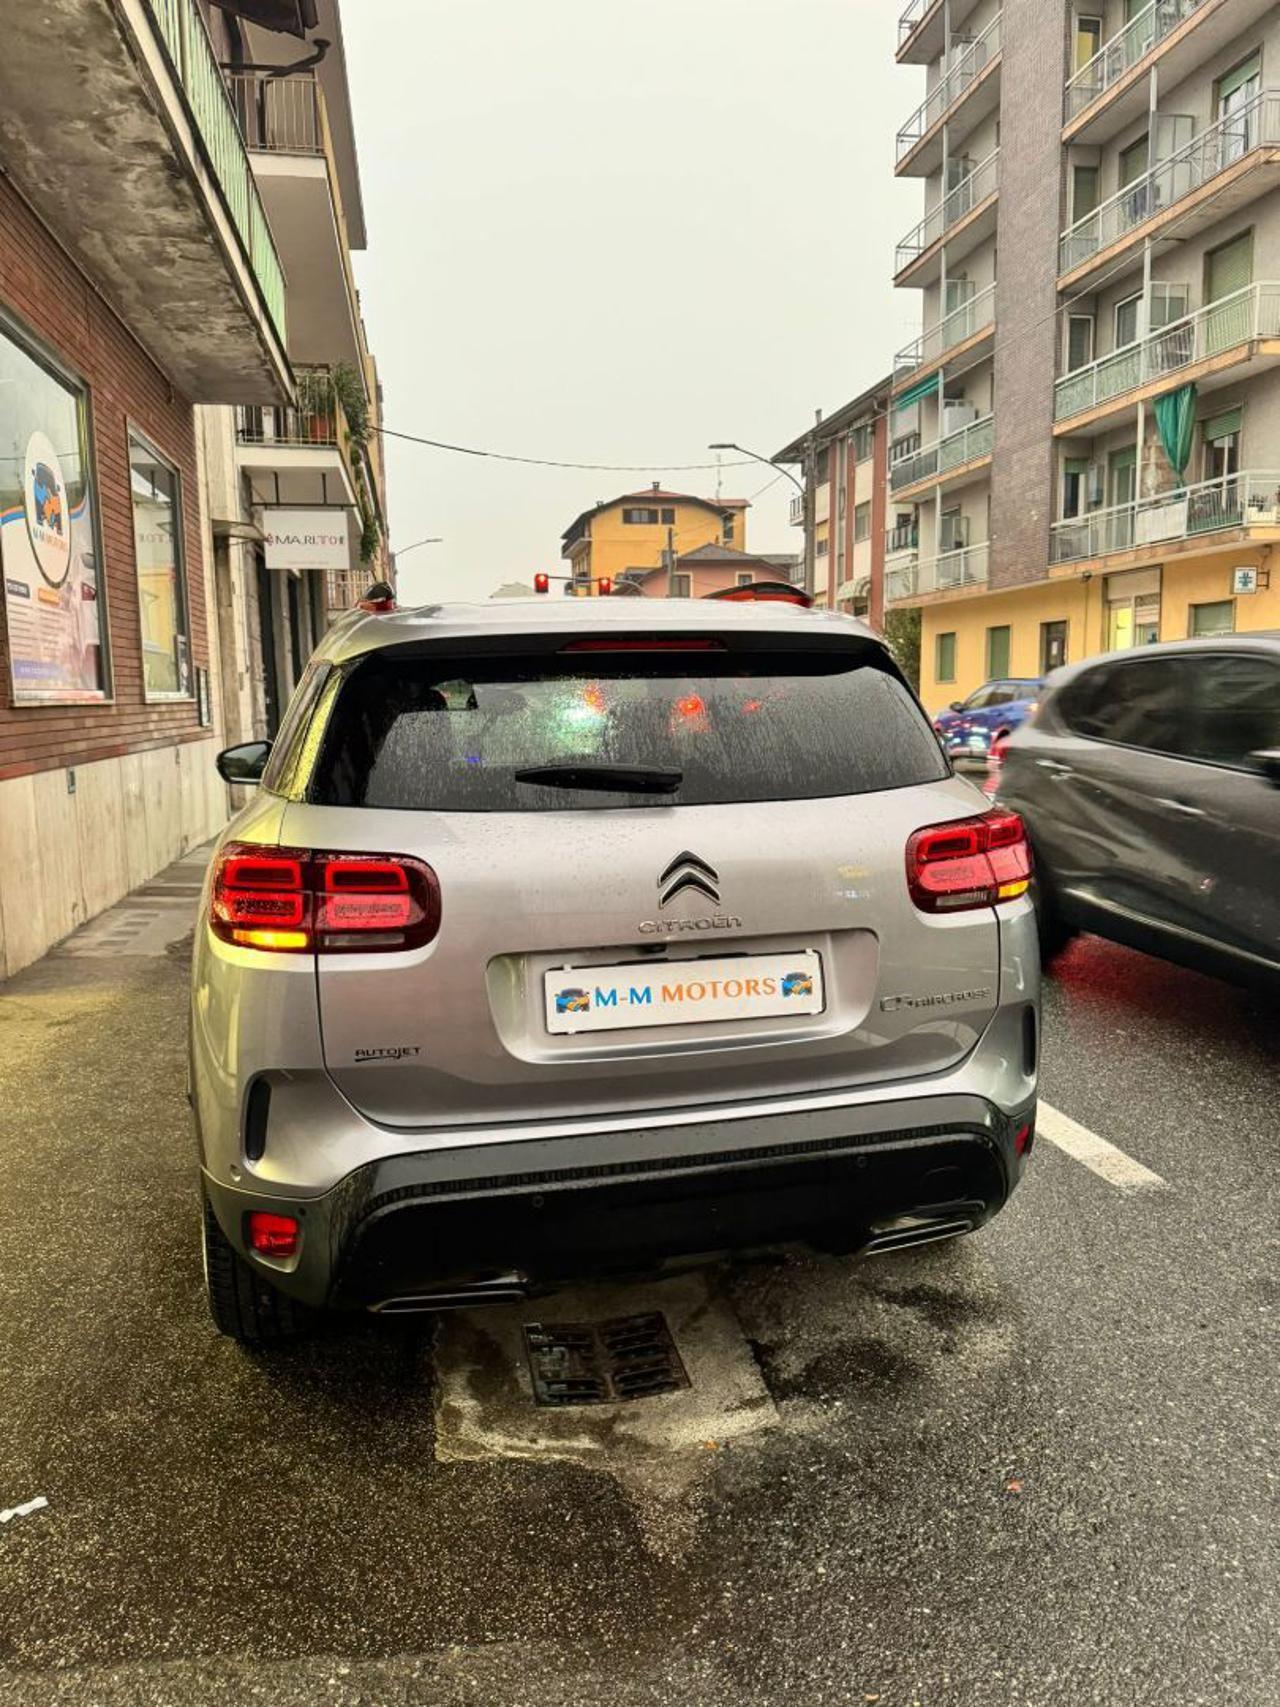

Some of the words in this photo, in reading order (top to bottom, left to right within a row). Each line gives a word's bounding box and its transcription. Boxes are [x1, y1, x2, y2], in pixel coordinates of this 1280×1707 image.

[638, 913, 742, 933] CITROËN
[595, 985, 652, 1007] M-M
[661, 977, 777, 1002] MOTORS
